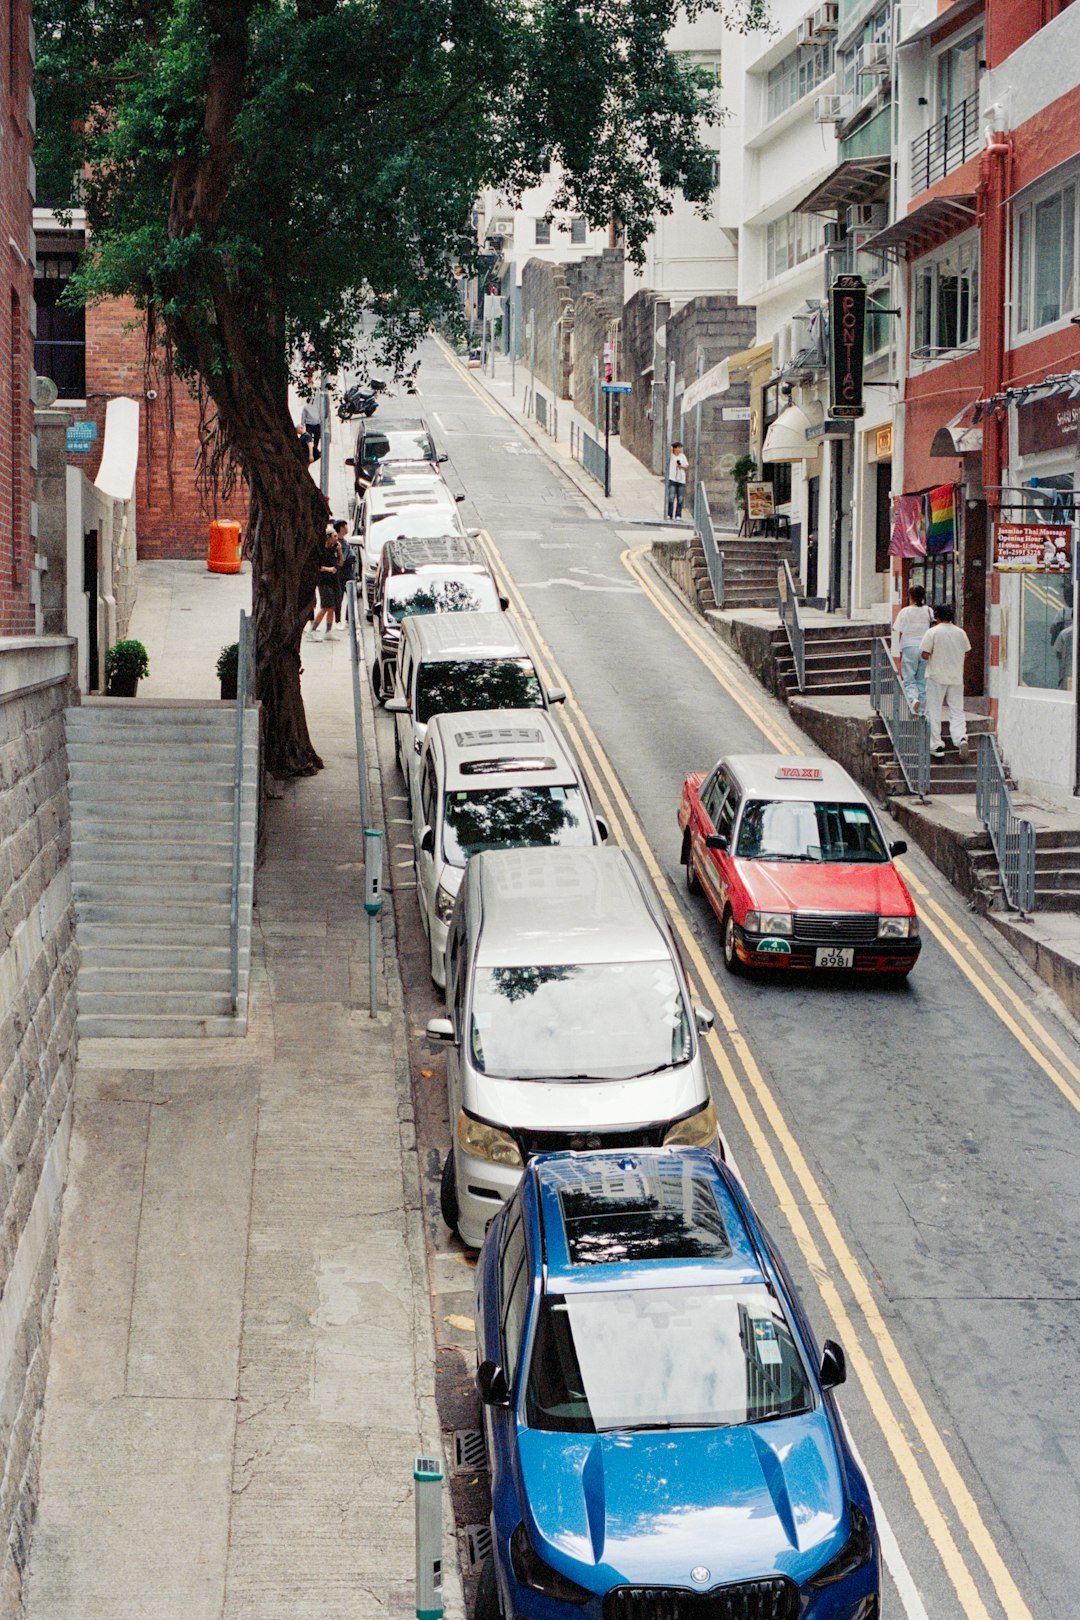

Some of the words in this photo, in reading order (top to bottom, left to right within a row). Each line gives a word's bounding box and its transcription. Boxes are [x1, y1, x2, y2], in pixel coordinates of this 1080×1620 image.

[840, 277, 860, 287] The
[842, 296, 857, 400] PONTIAC
[998, 527, 1023, 535] Jasmine
[1040, 528, 1067, 536] Massage
[998, 534, 1025, 542] Opening
[781, 768, 820, 778] TAXI
[828, 948, 843, 957] JZ
[820, 957, 849, 967] 8981
